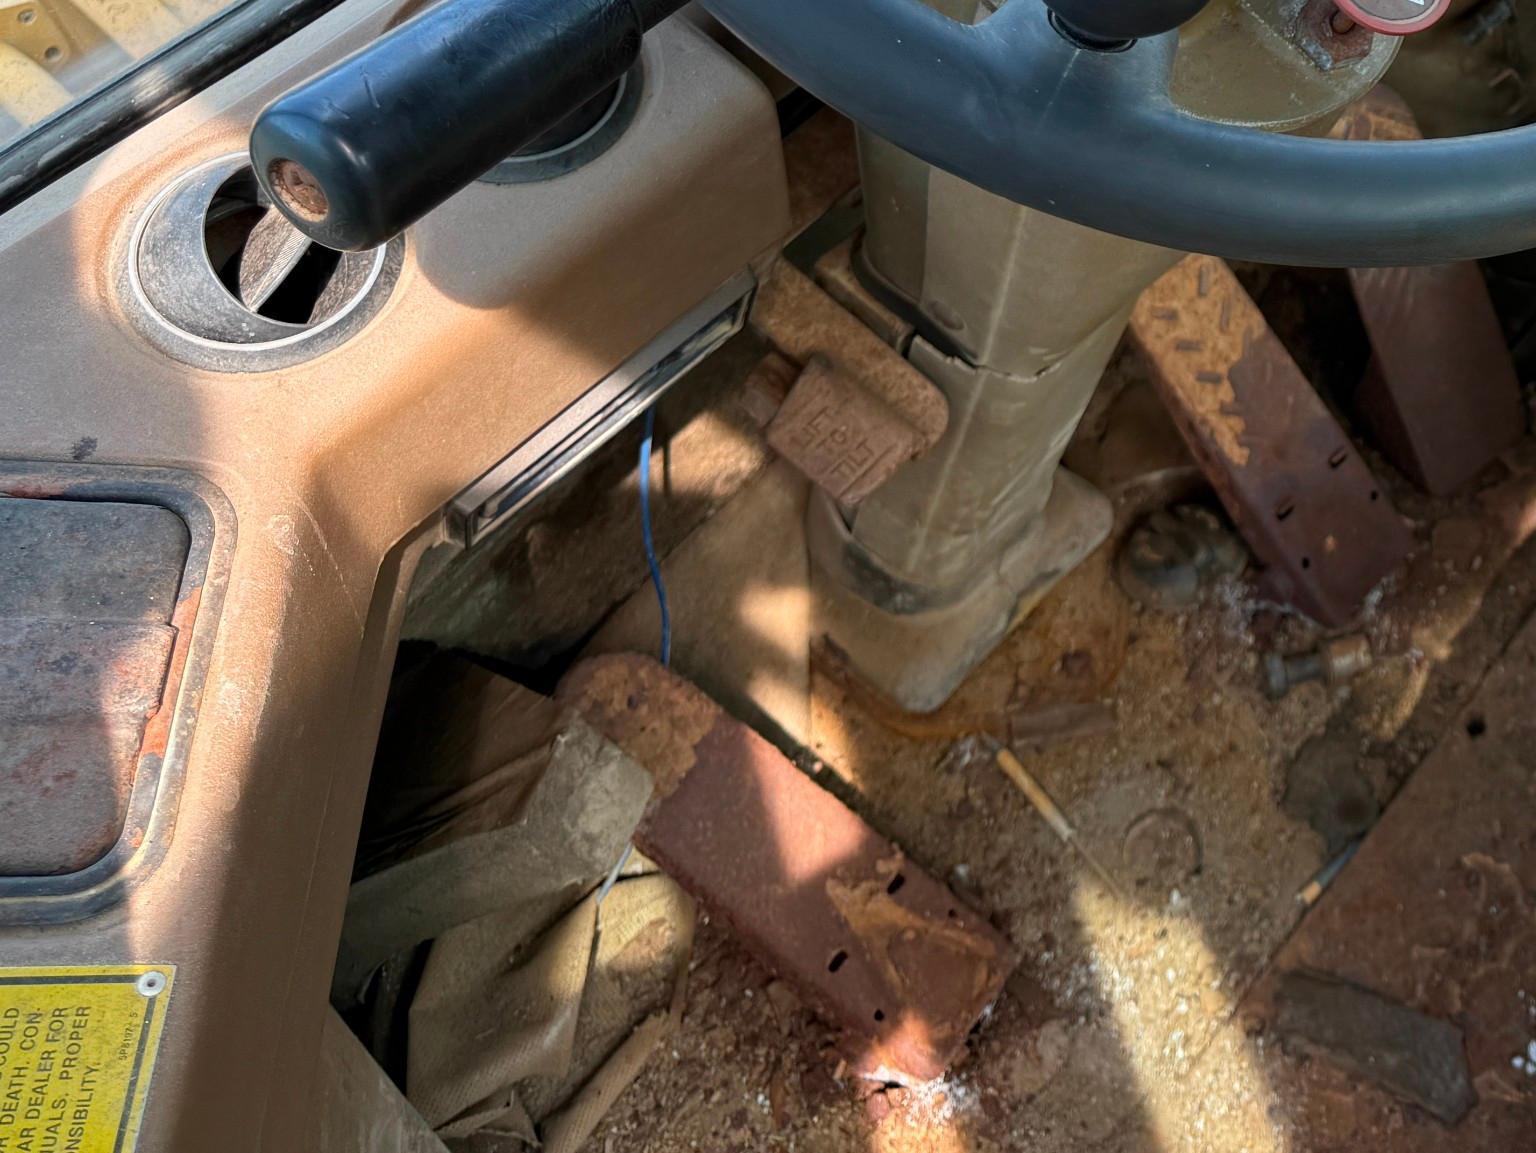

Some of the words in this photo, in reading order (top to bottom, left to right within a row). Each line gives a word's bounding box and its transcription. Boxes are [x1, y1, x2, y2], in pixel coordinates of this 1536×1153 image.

[829, 437, 875, 480] TILT
[0, 1061, 30, 1125] DEATH.
[24, 1049, 57, 1120] DEALER
[46, 1007, 68, 1043] FOR
[40, 1092, 69, 1153] UALS.
[59, 1006, 91, 1080] PROPER
[64, 1061, 100, 1153] NSIBILITY.
